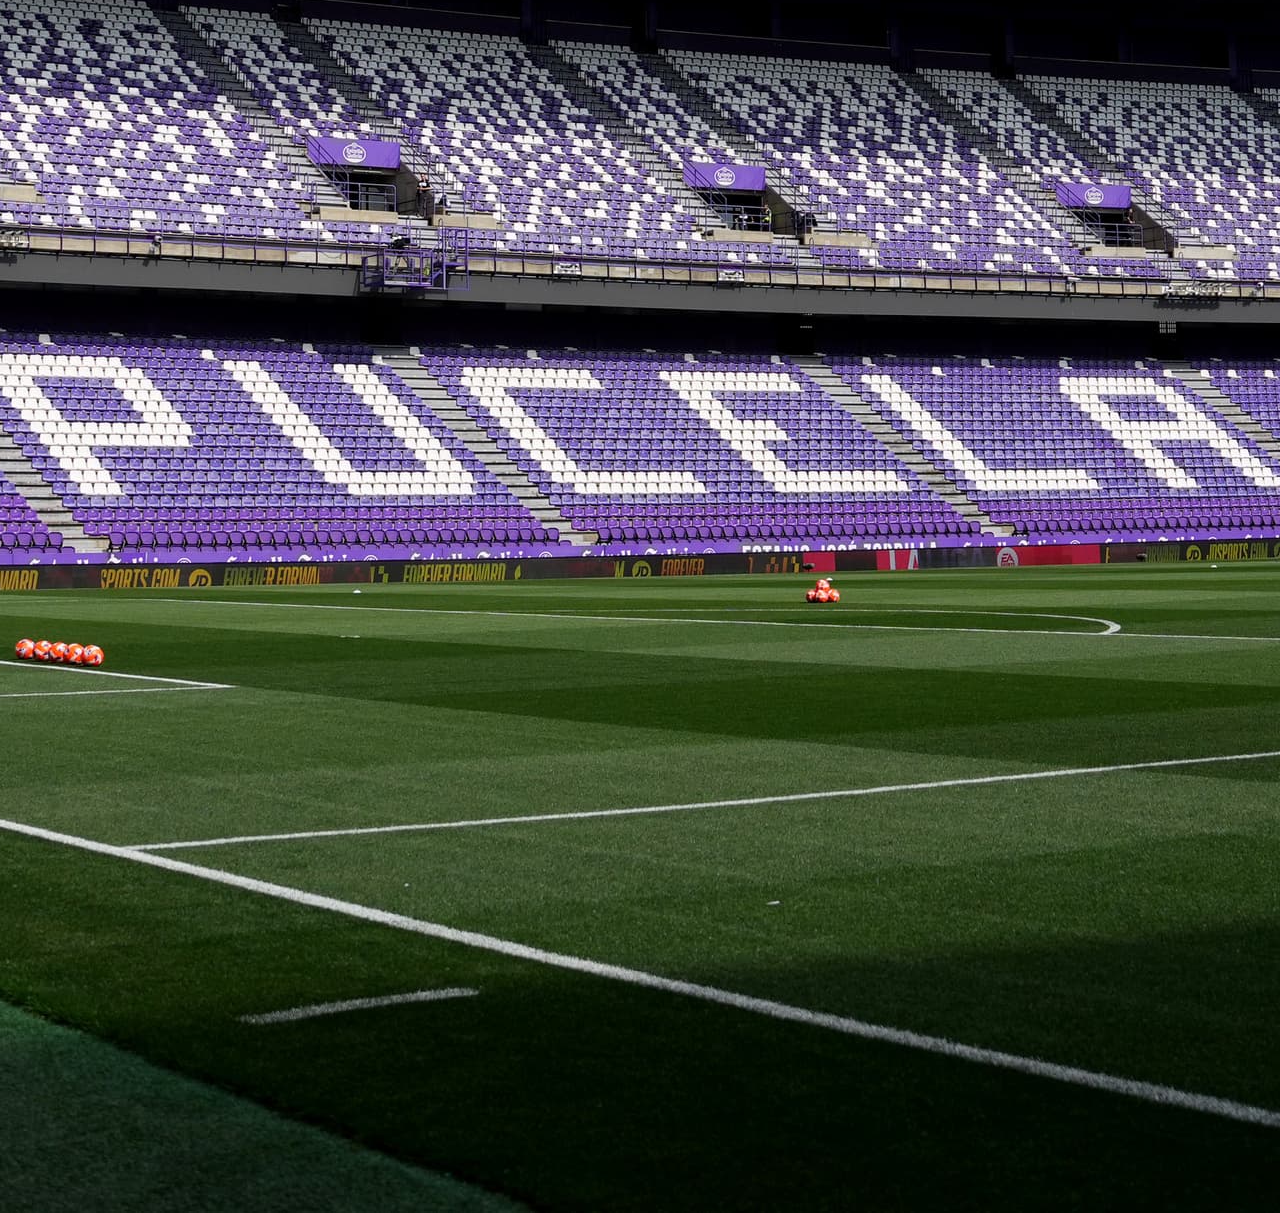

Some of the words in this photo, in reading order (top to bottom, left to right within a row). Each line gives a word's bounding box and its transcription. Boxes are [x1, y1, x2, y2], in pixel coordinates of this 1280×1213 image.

[403, 564, 452, 583] FOREVER
[452, 563, 507, 582] FORWARD
[661, 559, 705, 576] FOREVER
